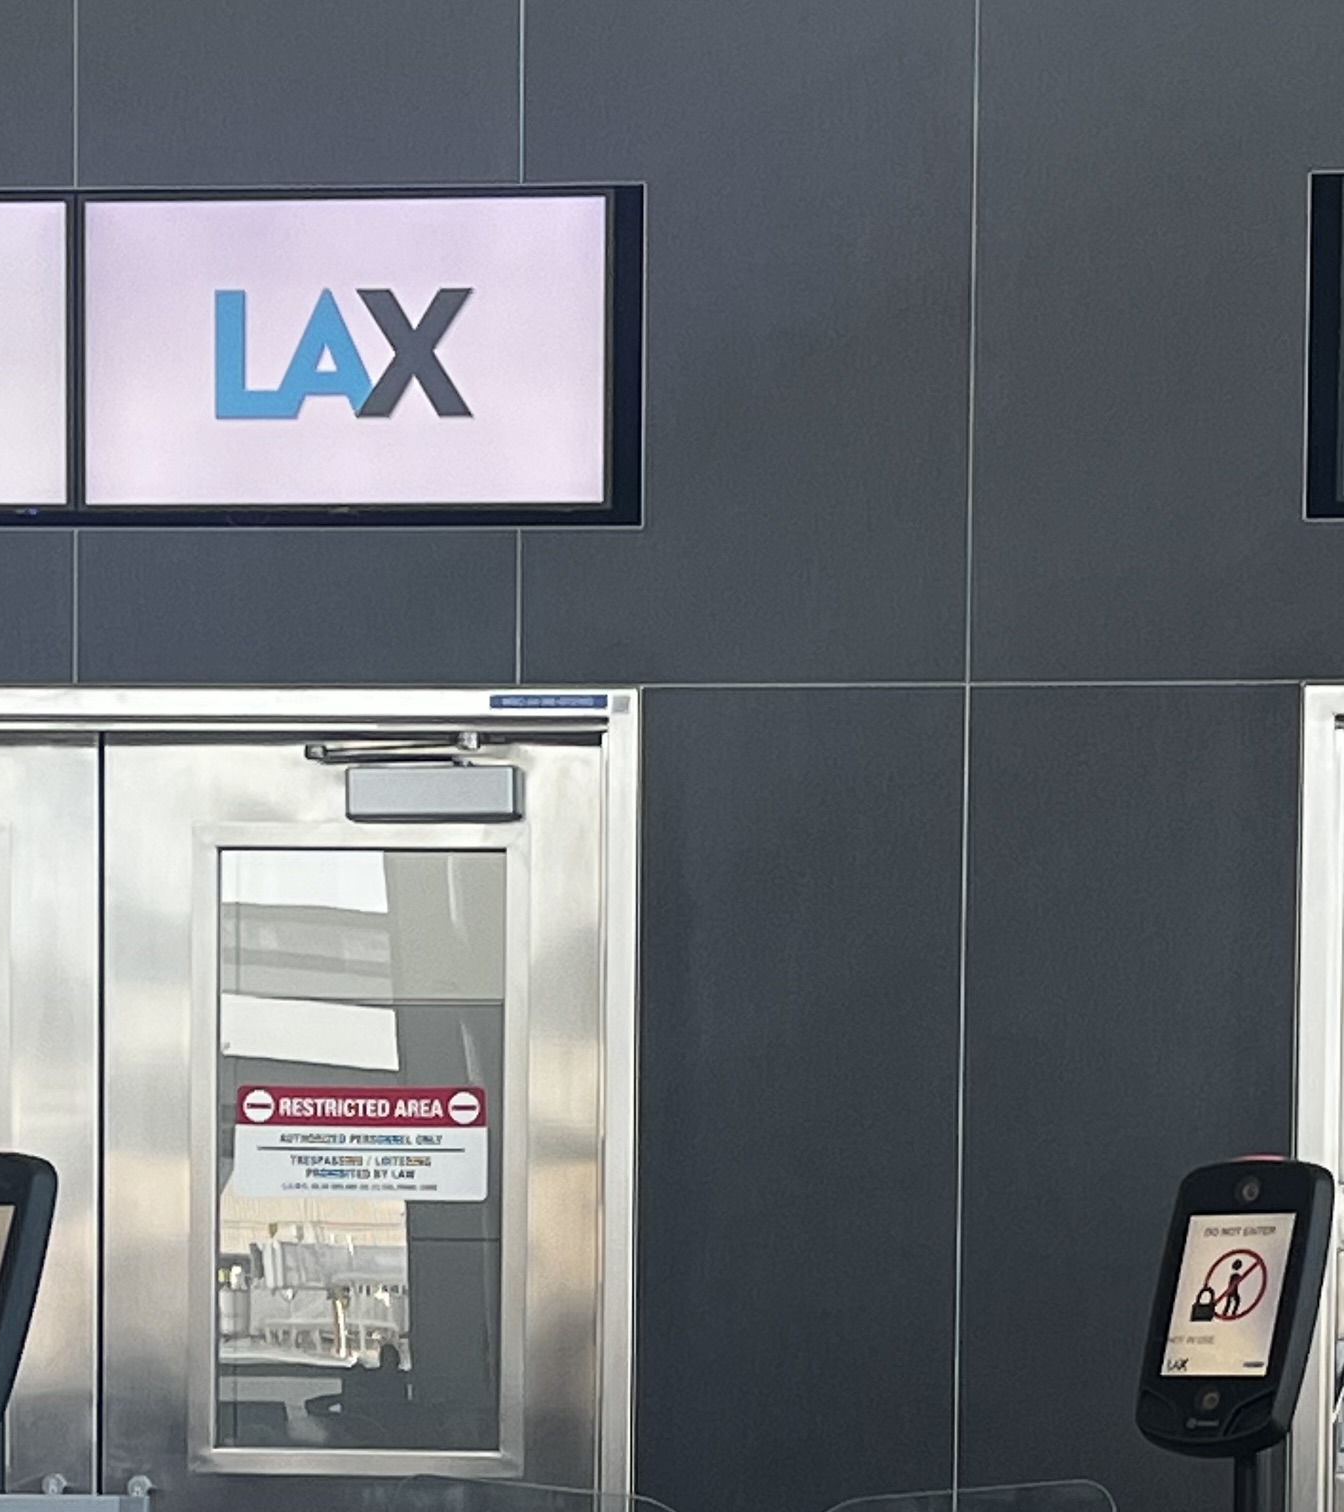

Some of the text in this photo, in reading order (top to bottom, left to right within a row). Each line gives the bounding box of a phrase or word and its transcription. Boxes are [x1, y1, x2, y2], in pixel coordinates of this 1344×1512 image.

[213, 287, 474, 419] LAX
[278, 1097, 443, 1118] RESTRICTED AREA
[279, 1133, 443, 1145] AUTHORIZED PERSONNEL ONLY
[289, 1155, 364, 1166] TRESPASSING
[375, 1156, 432, 1167] LOITERING
[305, 1168, 415, 1179] PROHIBITED BY LAW
